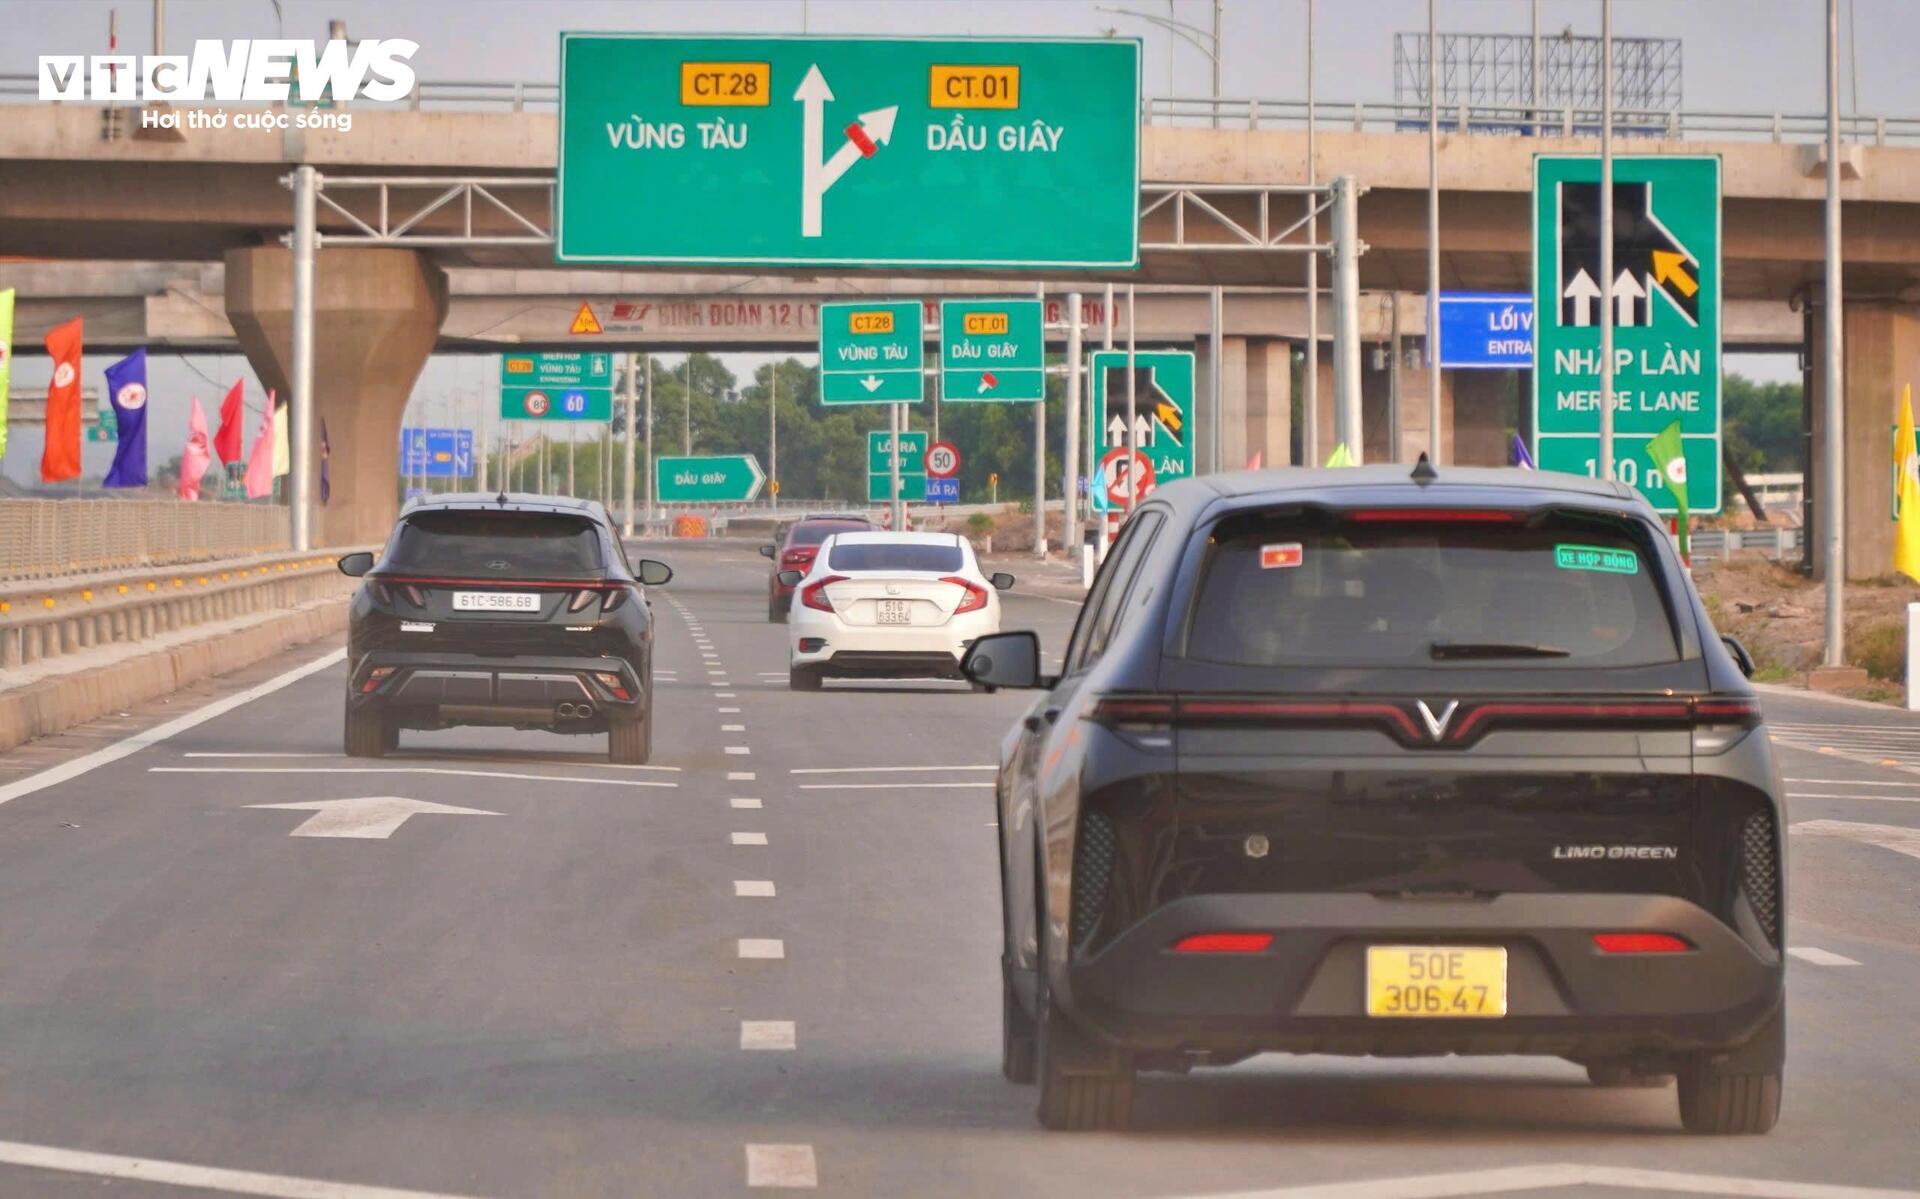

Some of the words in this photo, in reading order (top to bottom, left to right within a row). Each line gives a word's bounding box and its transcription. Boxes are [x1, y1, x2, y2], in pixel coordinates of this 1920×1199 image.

[693, 73, 758, 96] CT.28
[946, 75, 1009, 99] CT.01
[697, 116, 748, 149] TÀU
[927, 113, 987, 151] DẦU
[998, 119, 1064, 152] GIÂY
[854, 316, 891, 329] CT.28
[968, 316, 1006, 331] CT.01
[1490, 304, 1518, 331] LỐI
[952, 338, 981, 359] DẦU
[1488, 340, 1533, 355] ENTRA
[1640, 341, 1701, 376] LÀN
[566, 395, 585, 412] 60
[1639, 391, 1700, 412] LANE
[934, 452, 951, 469] 50
[1585, 458, 1638, 487] 10
[1560, 552, 1575, 563] XE
[1554, 846, 1606, 859] LIMO
[1608, 846, 1678, 859] GREEN
[1408, 952, 1465, 980] 50E
[1386, 984, 1489, 1012] 306.47
